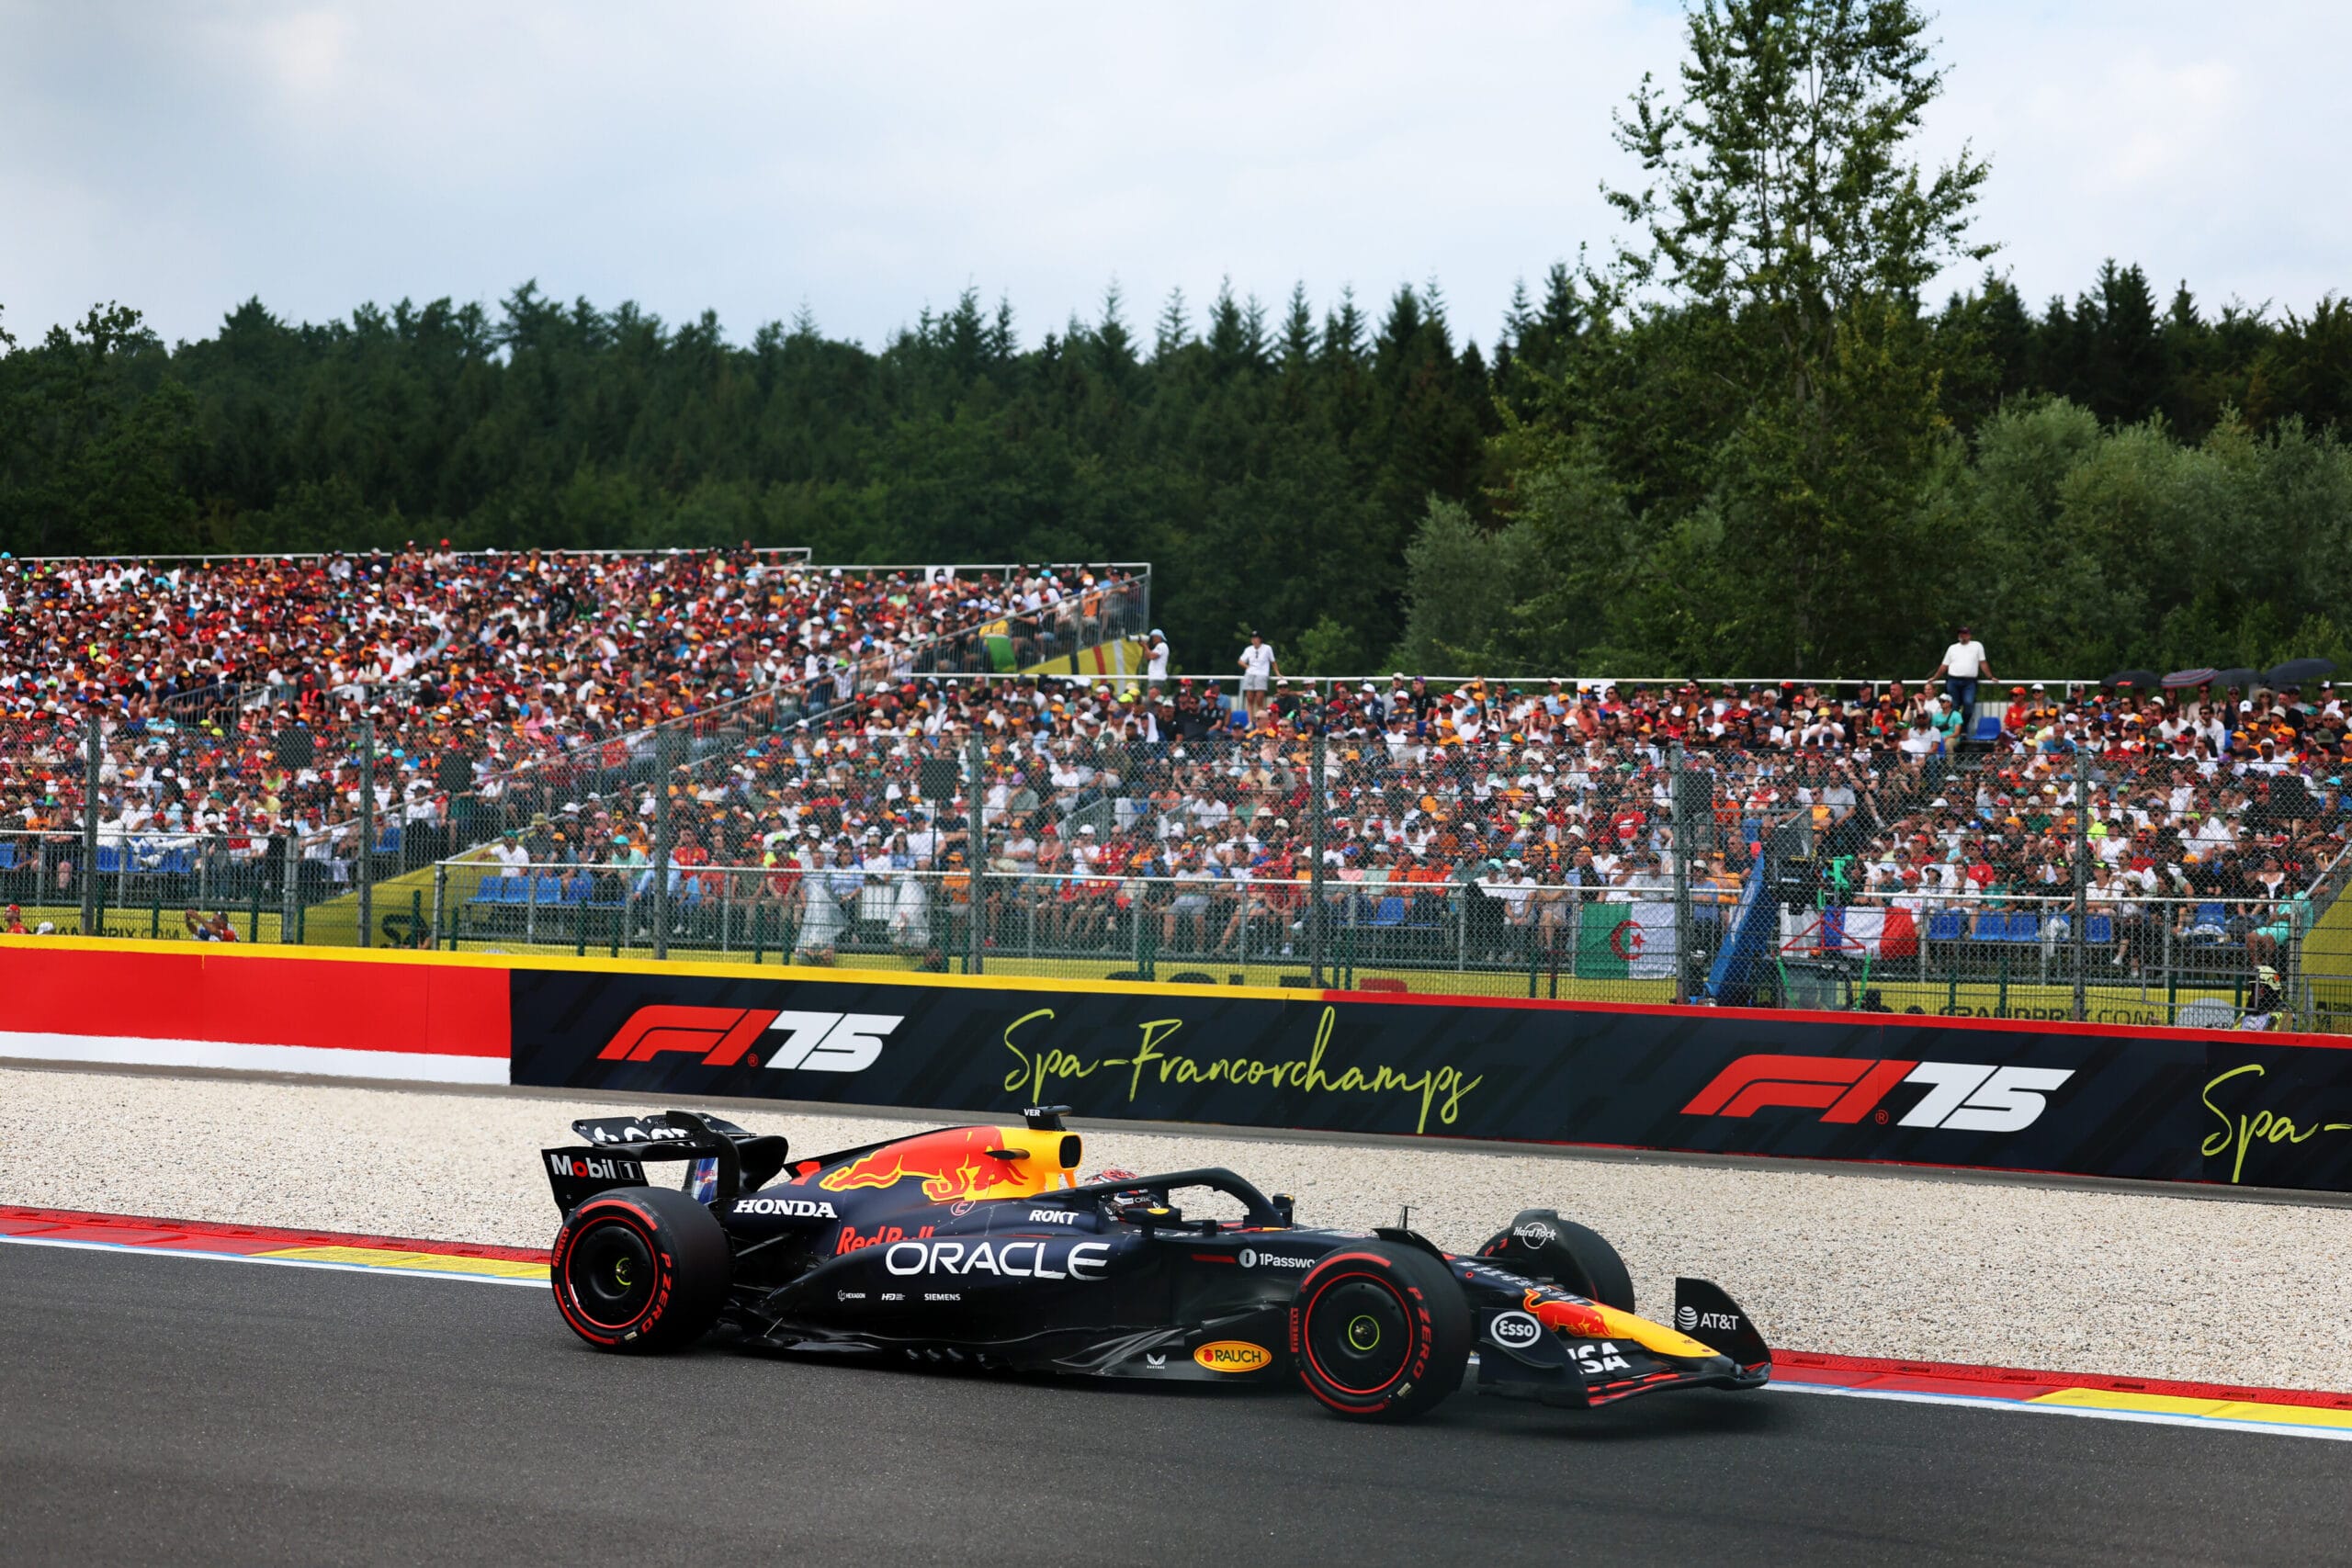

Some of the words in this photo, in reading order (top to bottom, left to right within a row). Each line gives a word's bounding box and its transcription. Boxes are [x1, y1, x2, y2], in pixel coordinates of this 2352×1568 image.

[597, 1004, 781, 1066] F1
[764, 1010, 905, 1072] 75
[1003, 1006, 1484, 1134] Spa-Francorchamps
[1679, 1054, 1920, 1124] F1
[1896, 1061, 2076, 1133] 75
[1023, 1108, 1041, 1117] VER
[550, 1154, 616, 1179] Mobil
[624, 1162, 634, 1179] 1
[733, 1198, 838, 1219] HONDA
[1029, 1209, 1079, 1225] ROKT
[836, 1225, 887, 1255] Red
[1513, 1226, 1535, 1237] Hard
[886, 1241, 1111, 1281] ORACLE
[1259, 1253, 1316, 1269] 1Passwo
[924, 1293, 961, 1302] SIEMENS
[1498, 1322, 1534, 1337] Esso
[1700, 1313, 1739, 1331] AT&T
[1215, 1349, 1261, 1363] RAUCH
